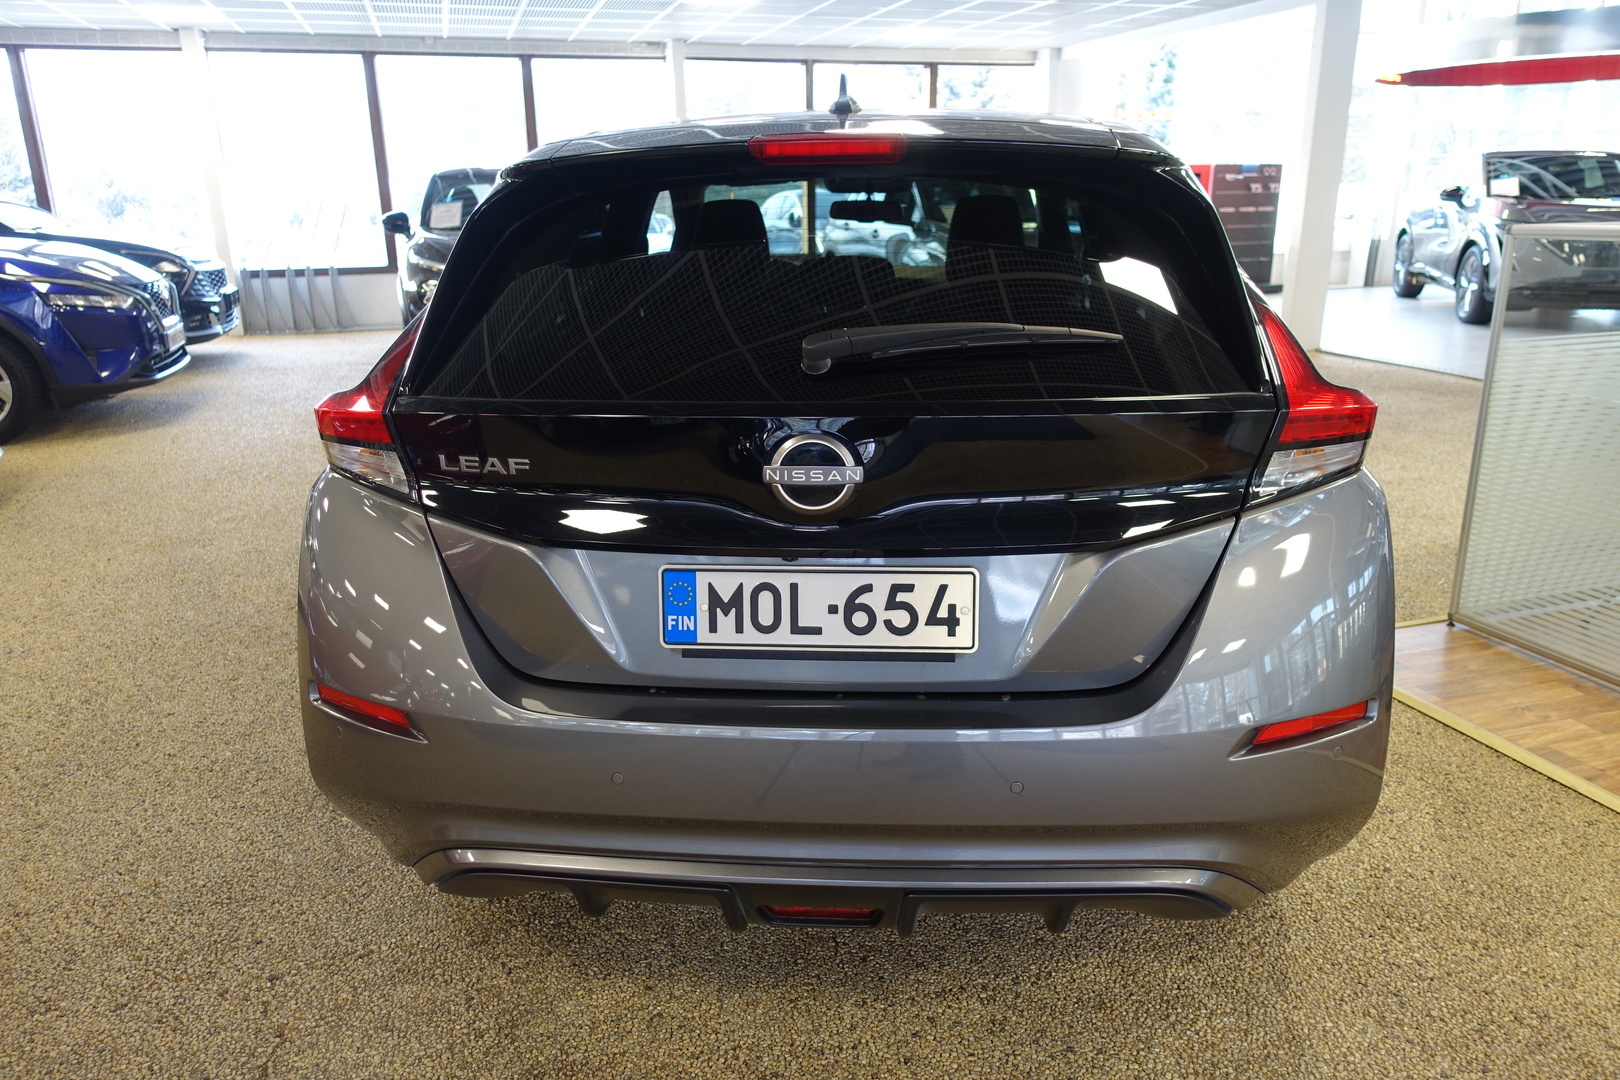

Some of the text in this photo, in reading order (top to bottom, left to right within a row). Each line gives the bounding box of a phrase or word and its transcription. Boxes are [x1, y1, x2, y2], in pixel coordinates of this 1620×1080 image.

[438, 454, 530, 475] LEAF
[766, 469, 860, 482] NISSAN
[708, 582, 960, 637] MOL-654
[667, 614, 695, 631] FIN
